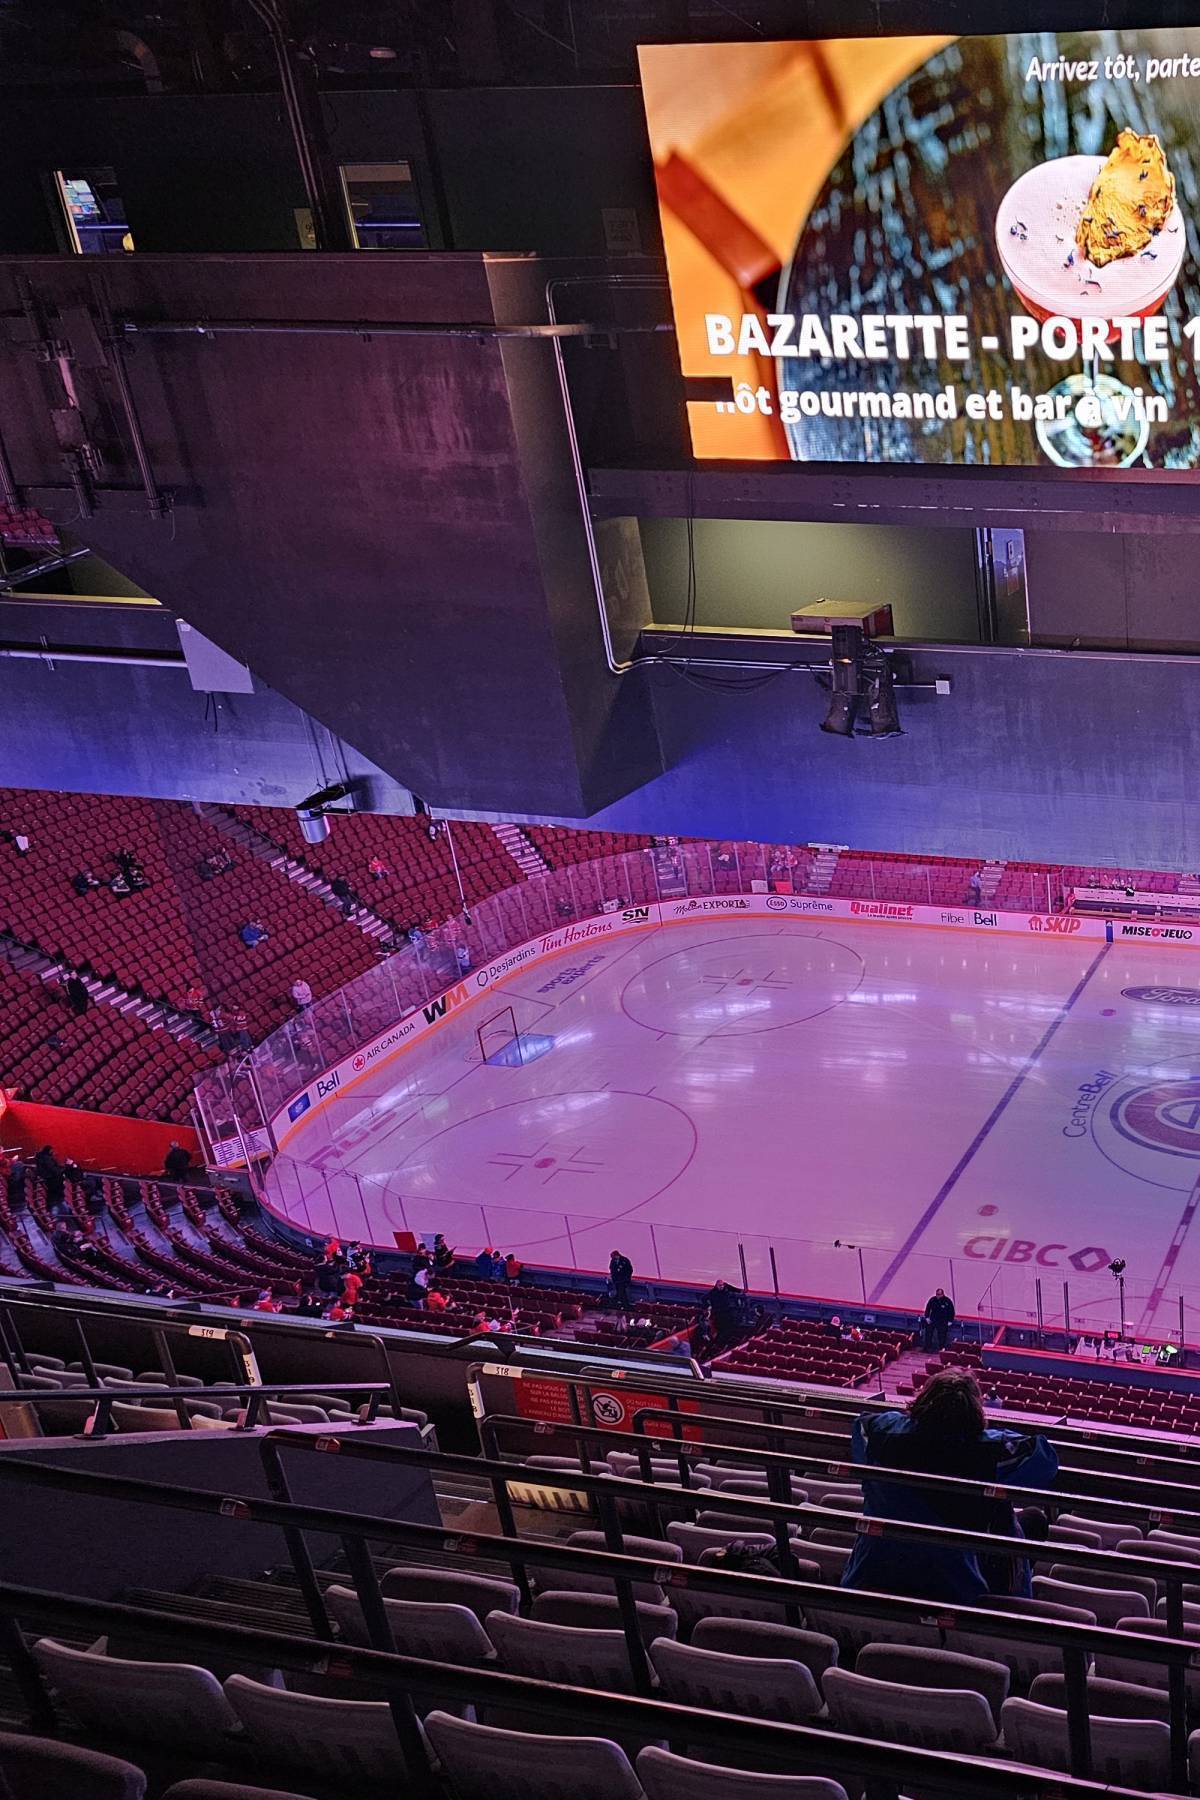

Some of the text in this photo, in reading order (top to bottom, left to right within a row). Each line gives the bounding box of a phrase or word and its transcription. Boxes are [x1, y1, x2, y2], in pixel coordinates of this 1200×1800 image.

[1025, 56, 1098, 82] Arrivez
[1103, 53, 1140, 83] tôt,
[704, 313, 970, 360] BAZARETTE
[1011, 315, 1172, 361] PORTE
[780, 386, 957, 424] gourmand
[965, 387, 1001, 420] et
[1011, 385, 1067, 421] bar
[1112, 386, 1167, 422] vin
[622, 907, 649, 922] SN
[790, 899, 833, 911] Suprême
[851, 902, 913, 916] Qualinet
[940, 912, 998, 927] Fibe Bell
[1043, 916, 1080, 933] SKIP
[539, 921, 612, 953] Tim Hortons
[490, 947, 536, 977] Desjardins
[422, 982, 469, 1024] WM
[365, 1022, 415, 1061] AIR CANADA
[316, 1071, 340, 1098] Bell
[962, 1236, 1068, 1267] CIBC
[201, 1328, 214, 1338] 319
[496, 1366, 509, 1376] 318
